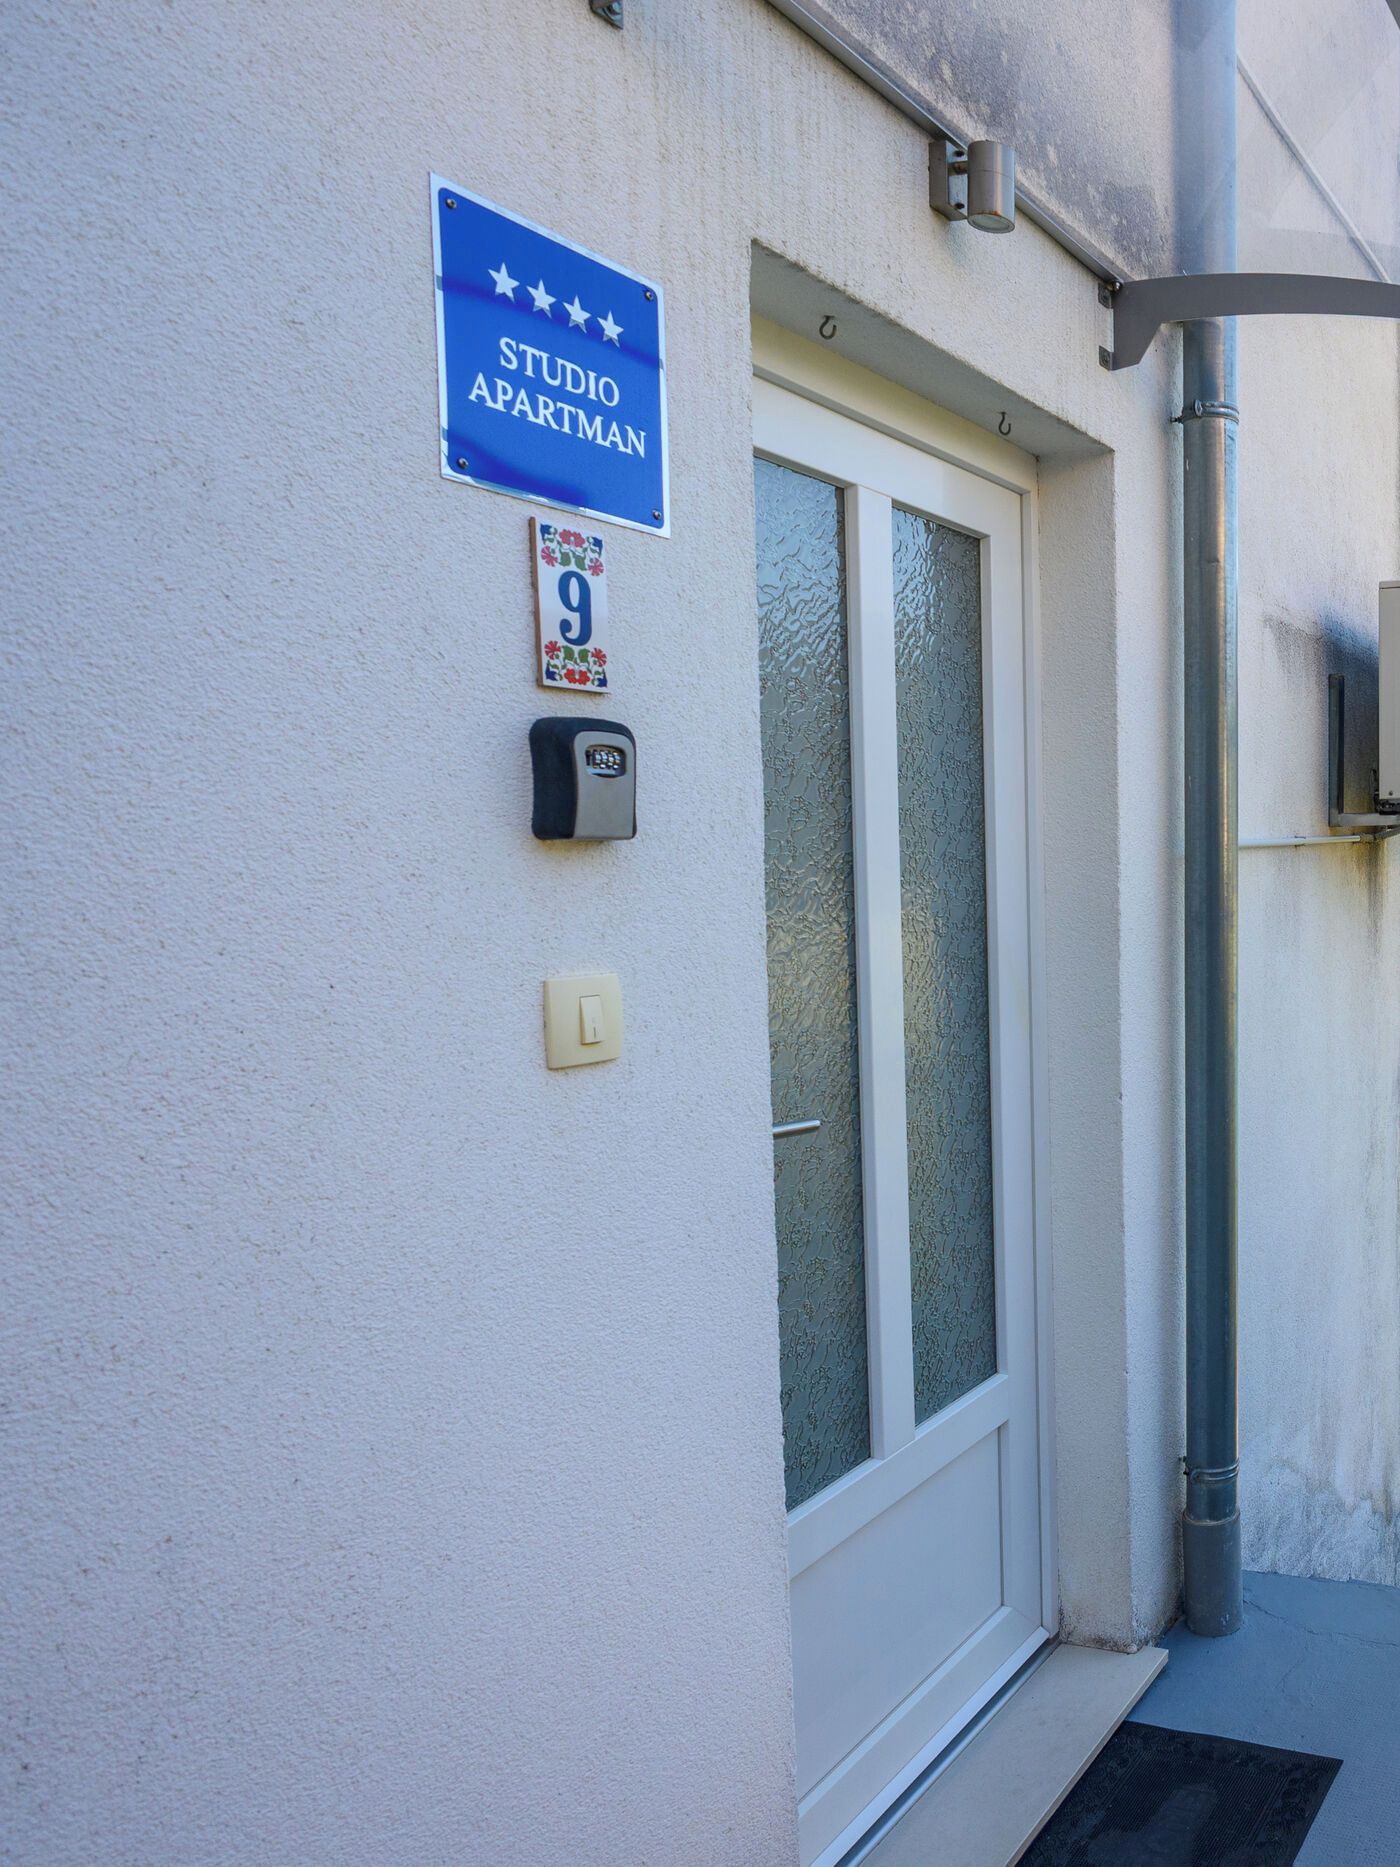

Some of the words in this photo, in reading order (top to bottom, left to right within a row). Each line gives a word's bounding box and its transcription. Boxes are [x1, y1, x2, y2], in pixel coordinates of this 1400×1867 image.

[499, 337, 620, 407] STUDIO
[468, 372, 646, 458] APARTMAN
[558, 570, 592, 647] 9
